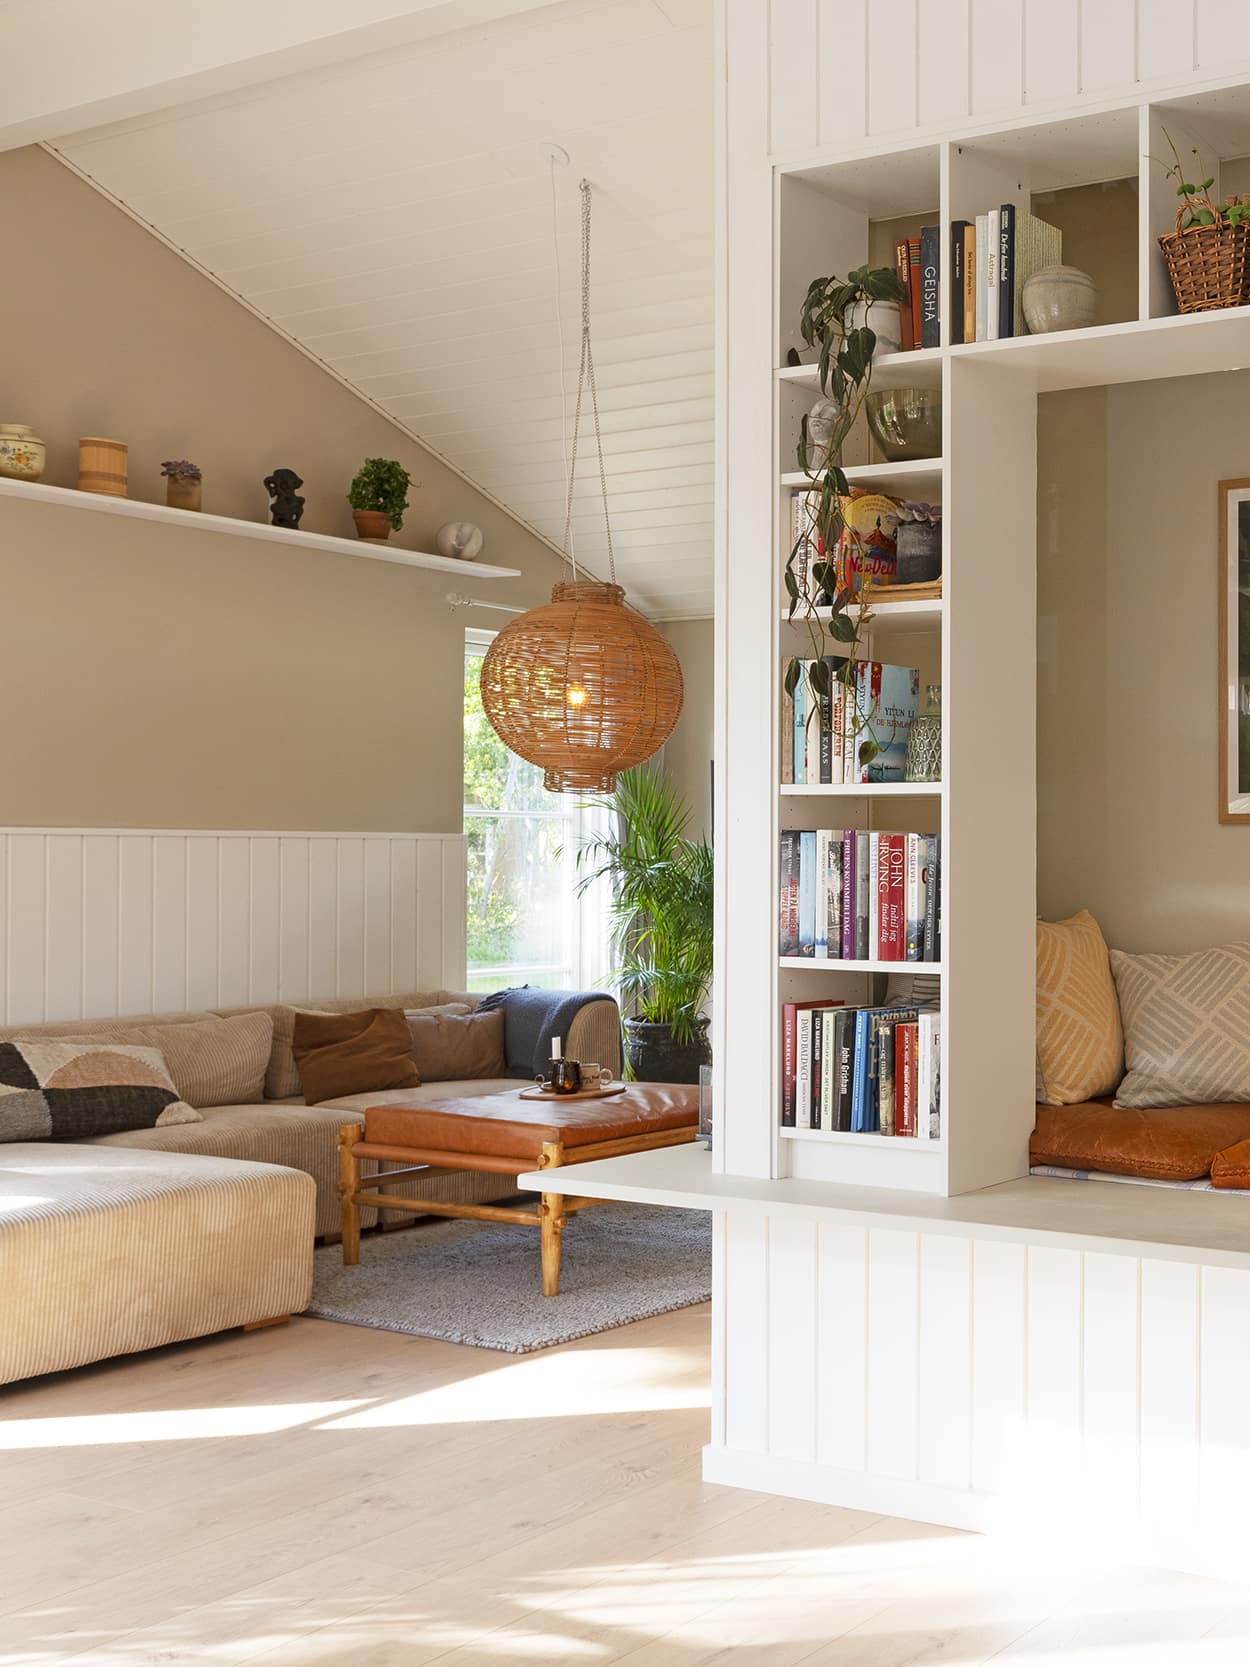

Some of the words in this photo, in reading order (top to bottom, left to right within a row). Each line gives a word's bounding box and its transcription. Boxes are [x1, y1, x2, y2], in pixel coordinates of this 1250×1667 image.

[987, 254, 997, 289] Astragal
[924, 266, 937, 322] GEISHA
[879, 842, 889, 893] IRVING
[890, 848, 904, 887] JOHN
[843, 917, 851, 934] DAG
[881, 903, 890, 928] finder
[889, 904, 899, 928] Indtil
[880, 929, 890, 943] dig
[888, 929, 898, 942] jeg
[800, 1019, 809, 1043] DAVID
[800, 1043, 809, 1081] BALDACCI
[840, 1046, 850, 1064] John
[840, 1064, 850, 1095] Grisham
